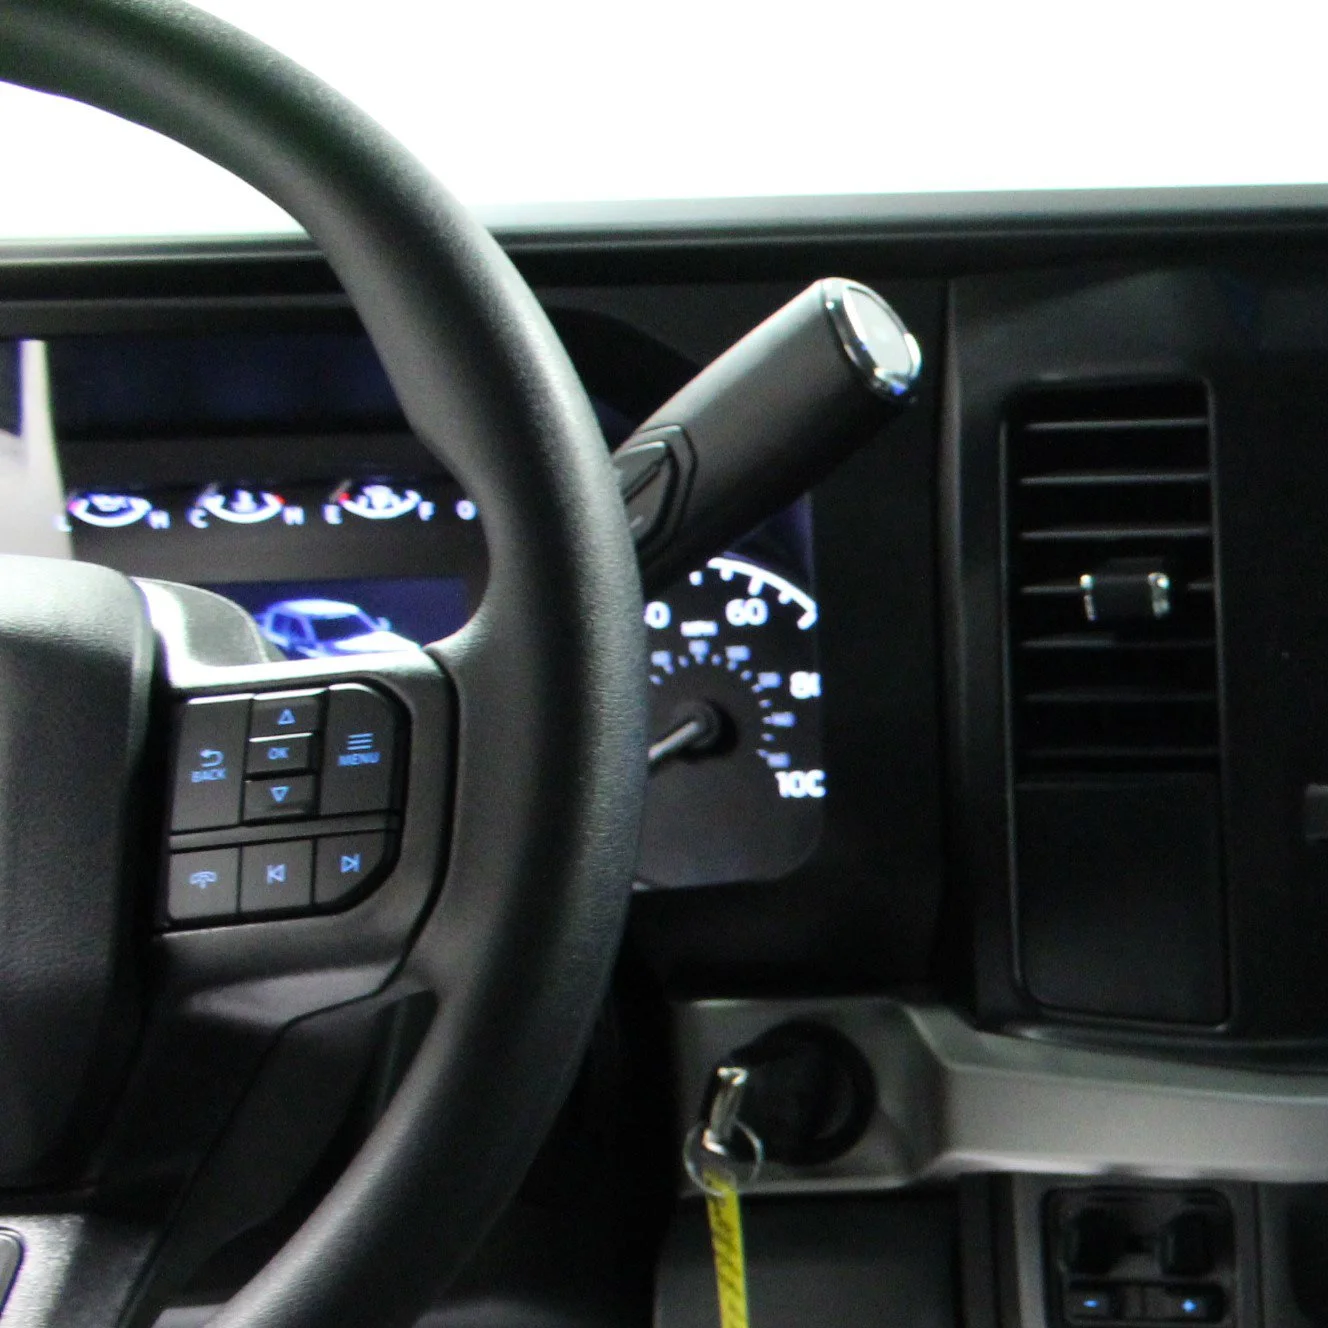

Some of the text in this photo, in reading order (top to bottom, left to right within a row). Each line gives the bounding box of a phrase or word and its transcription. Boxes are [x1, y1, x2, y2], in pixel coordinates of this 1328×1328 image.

[644, 601, 671, 629] 0
[725, 598, 769, 627] 60
[267, 747, 290, 761] OK
[337, 752, 381, 767] MENU
[191, 768, 227, 783] BACK
